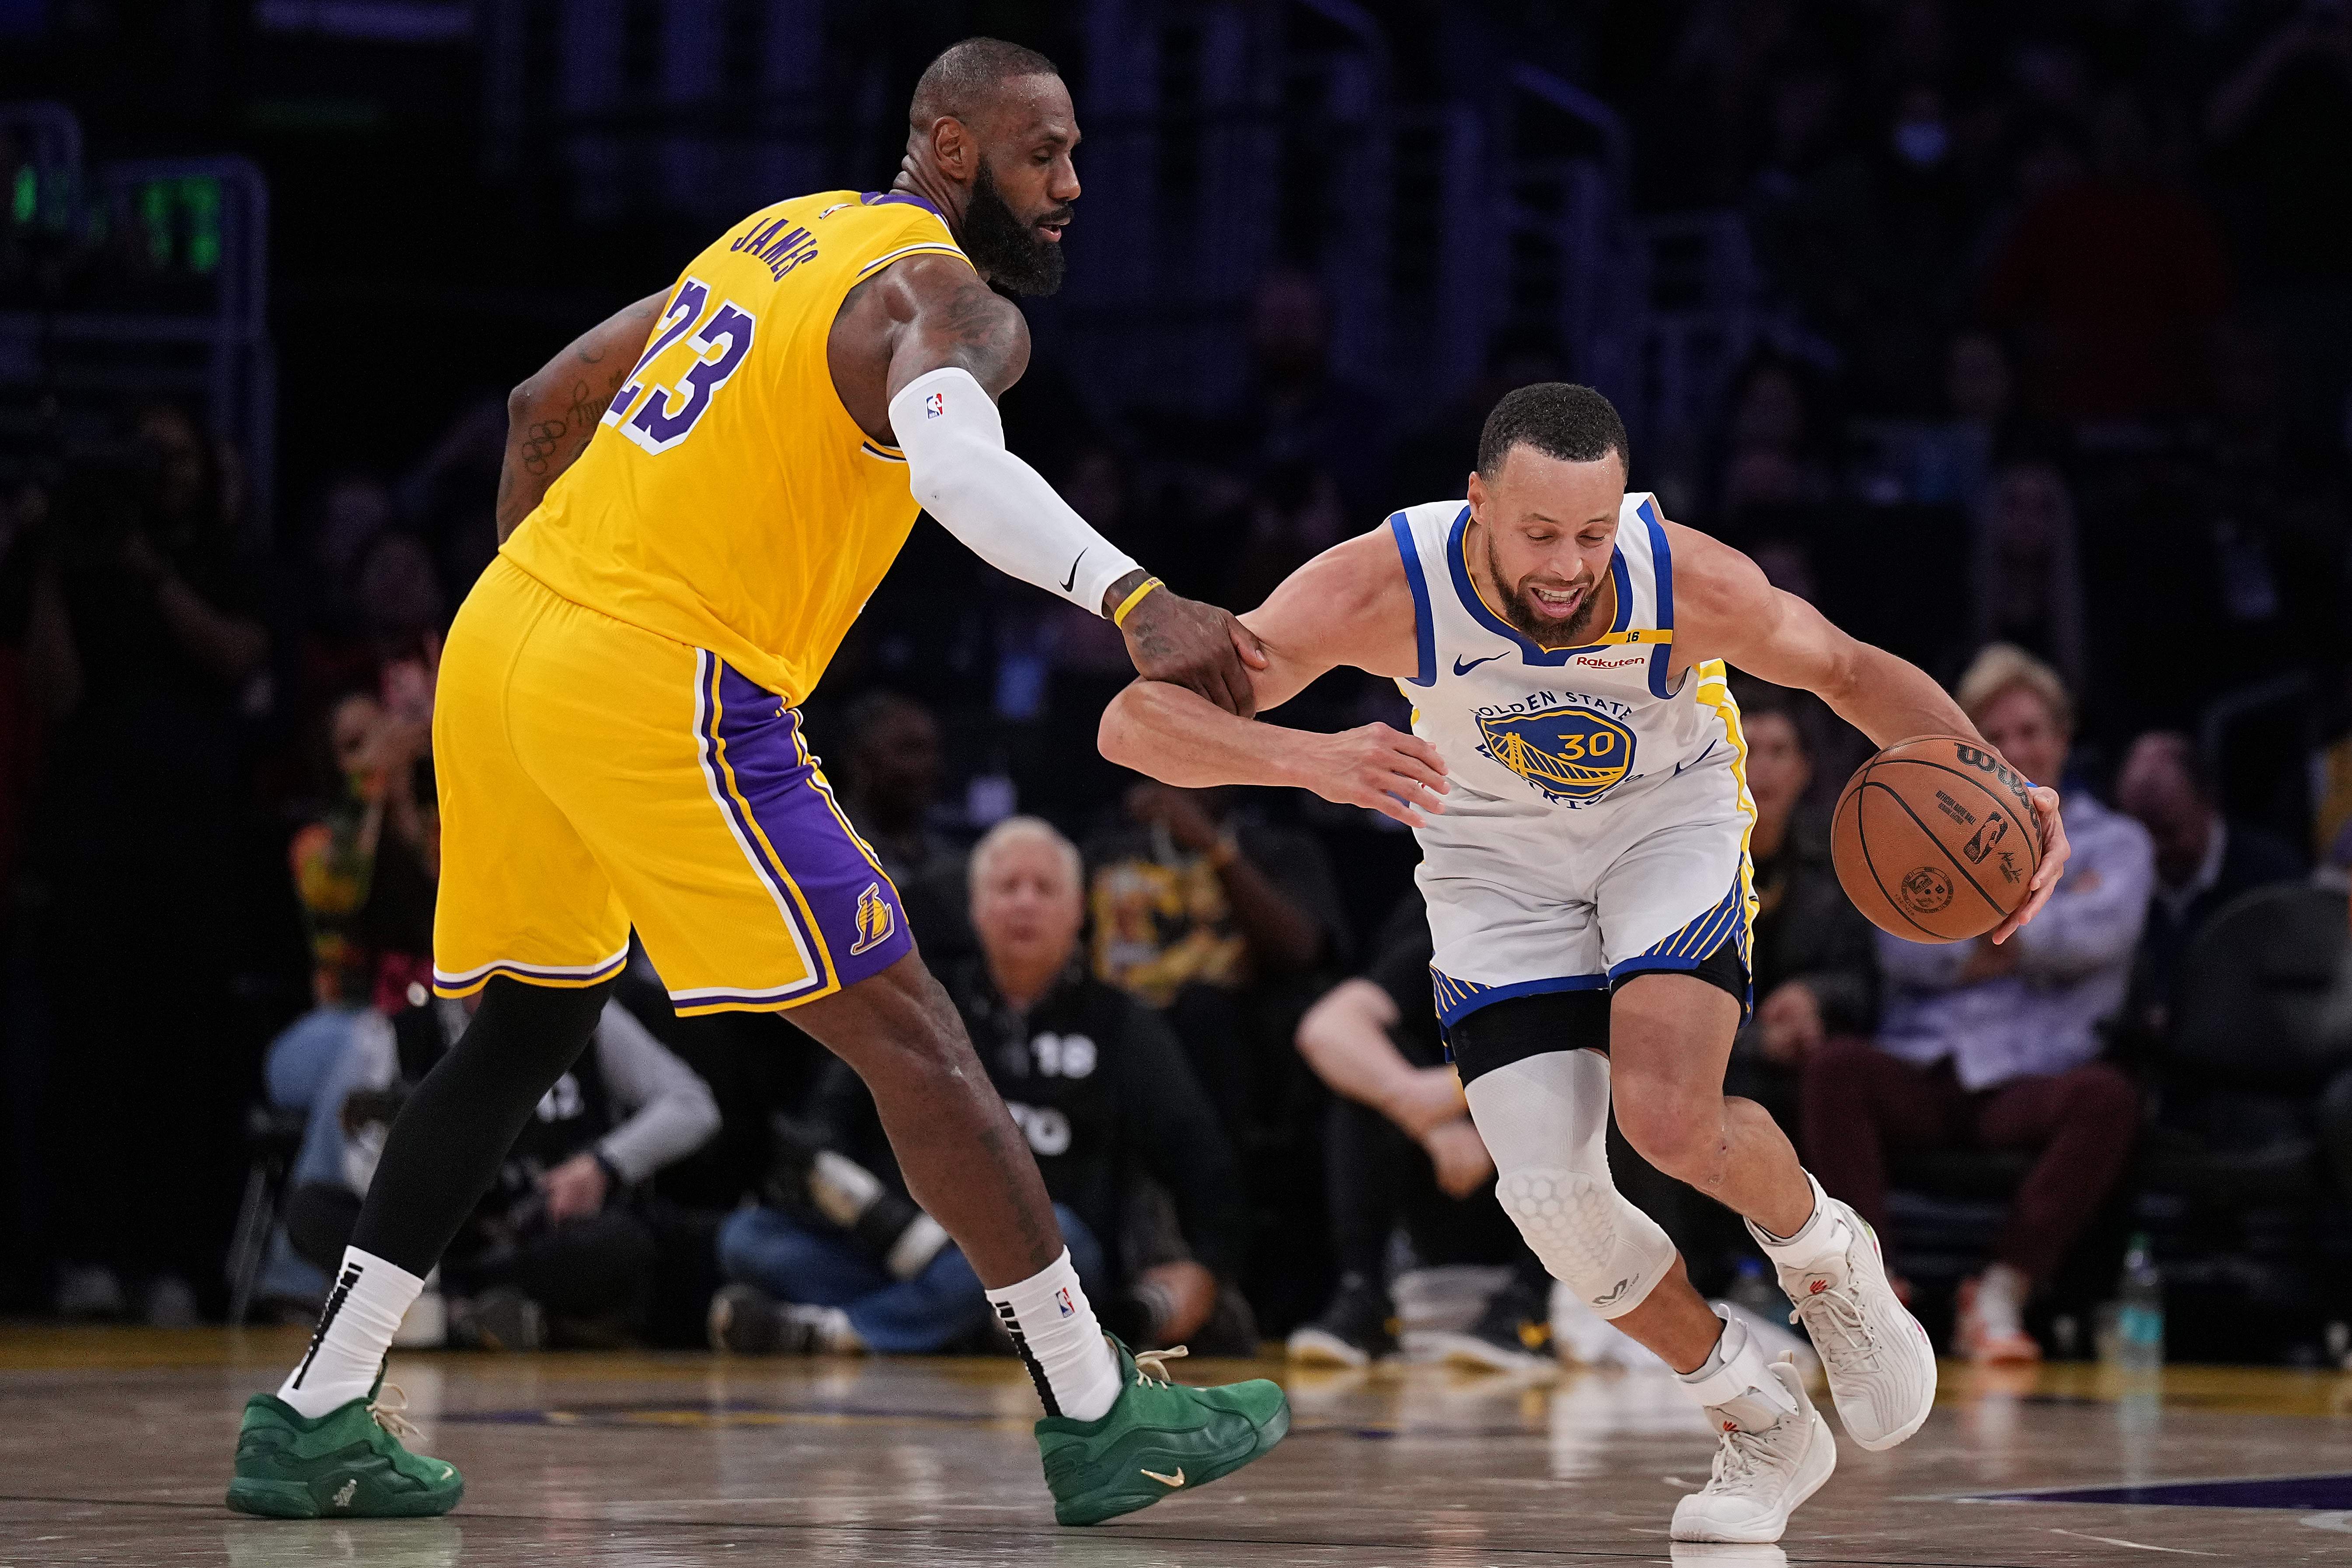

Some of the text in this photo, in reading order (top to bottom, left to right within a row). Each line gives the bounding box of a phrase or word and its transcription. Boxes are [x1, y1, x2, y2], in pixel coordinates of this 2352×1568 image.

[730, 217, 818, 282] JAMES
[600, 275, 756, 456] 23
[1626, 631, 1640, 643] 16
[1576, 657, 1645, 668] Rakuten
[1565, 692, 1632, 721] STATE
[1558, 732, 1614, 760] 30
